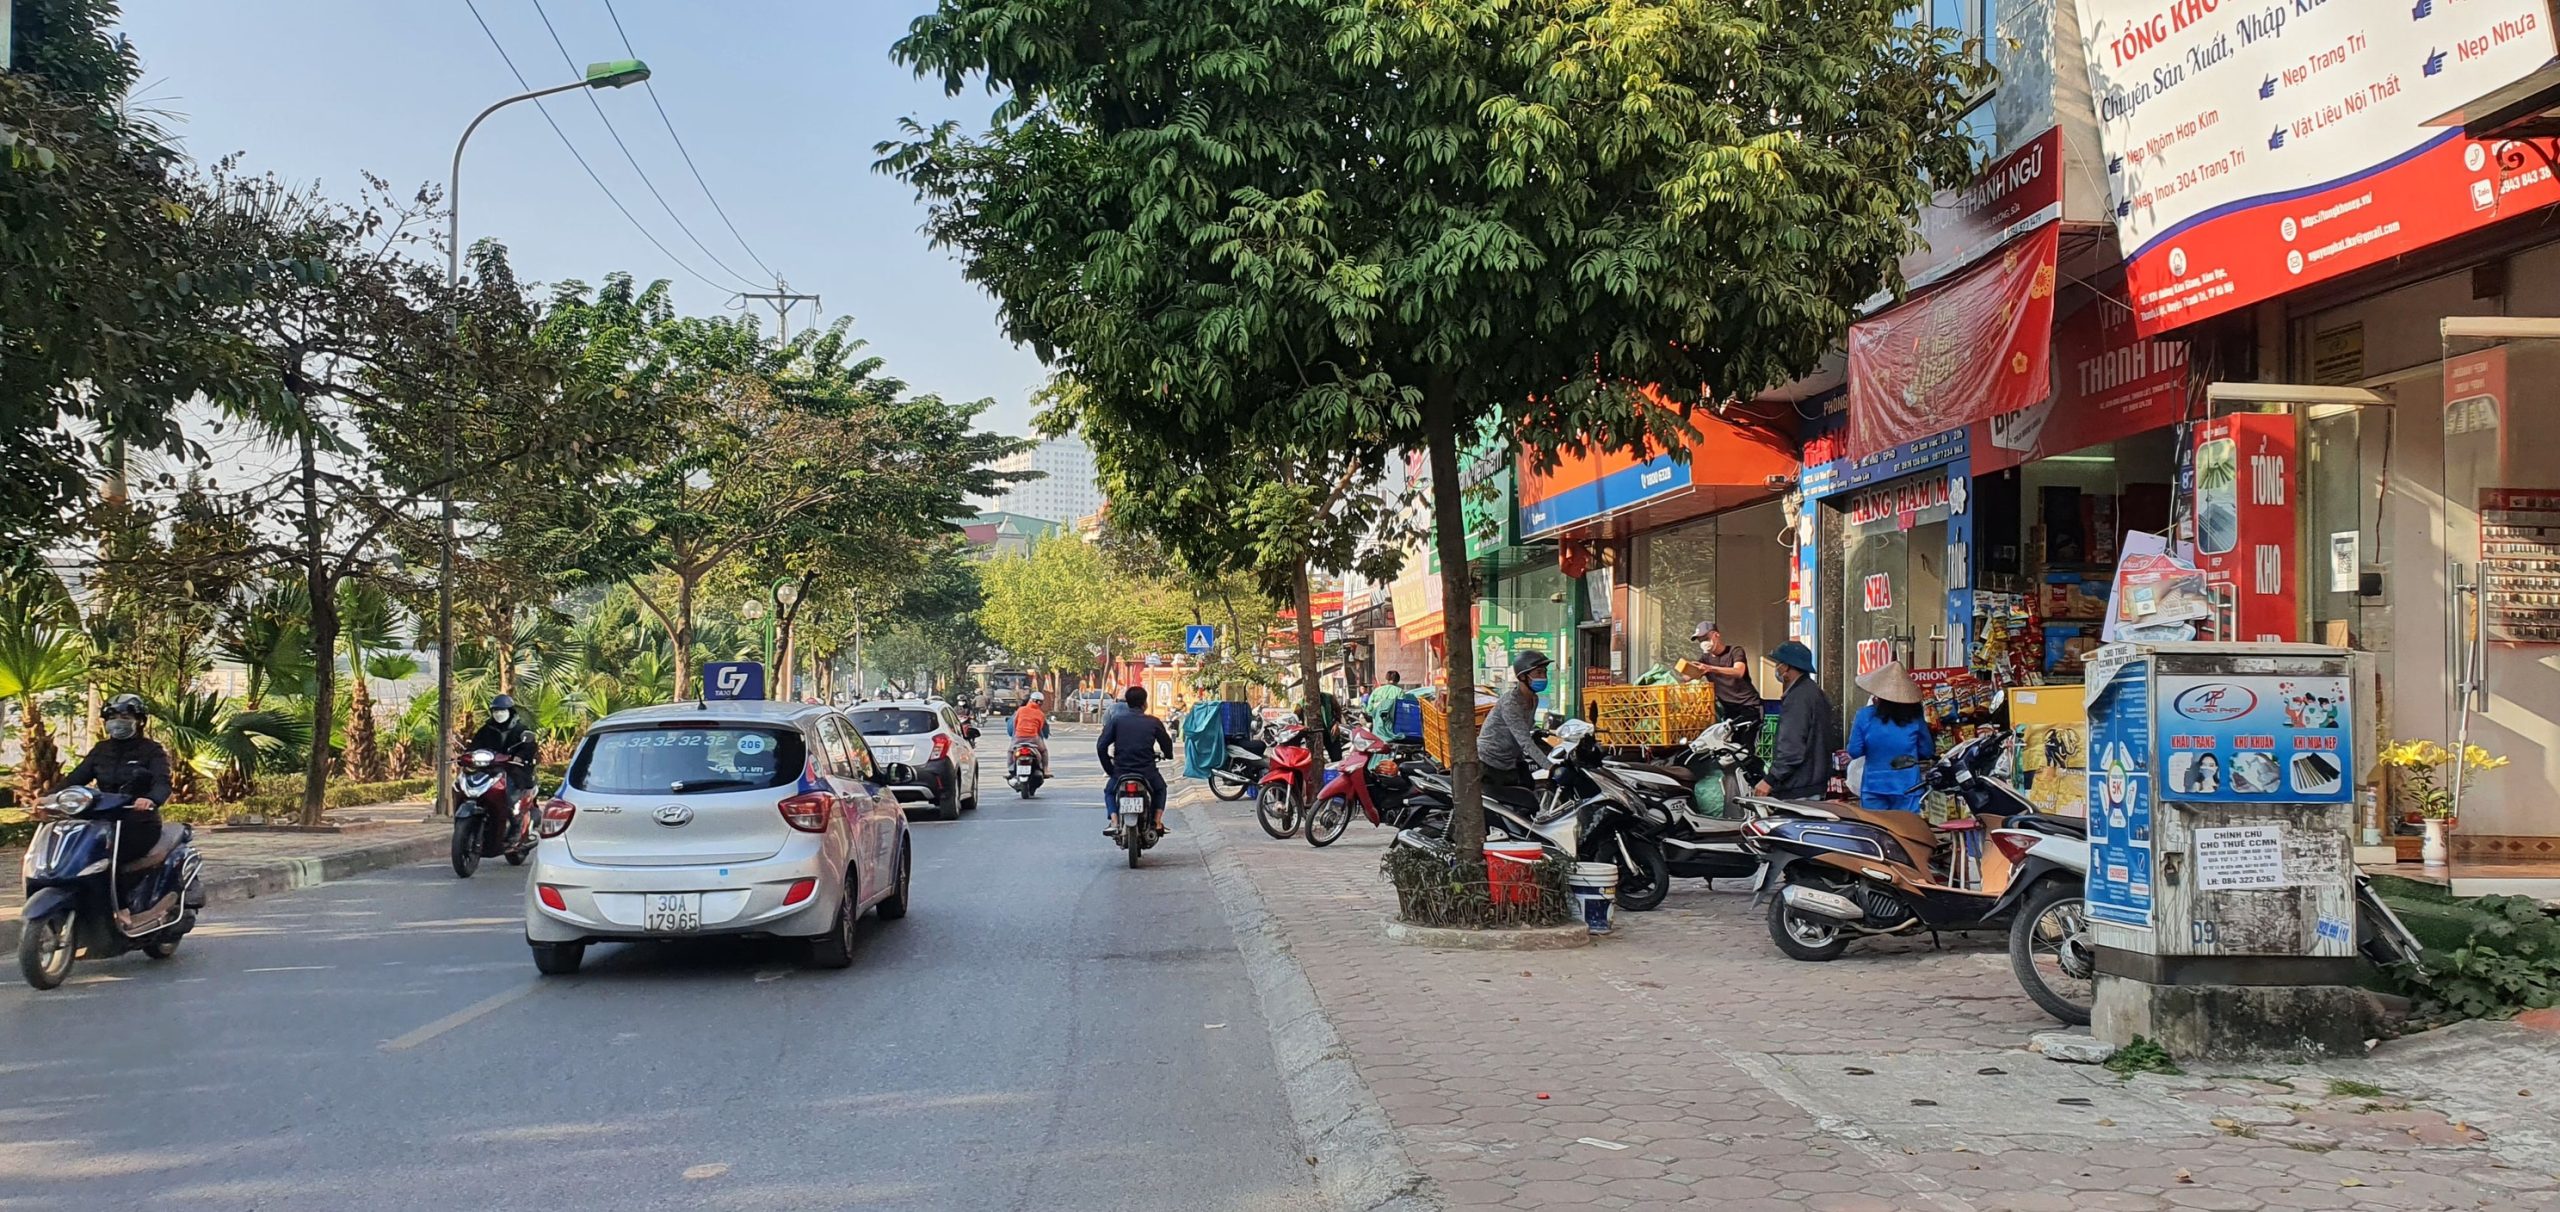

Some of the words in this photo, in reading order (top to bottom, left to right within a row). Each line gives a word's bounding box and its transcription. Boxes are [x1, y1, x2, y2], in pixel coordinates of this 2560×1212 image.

[2110, 14, 2167, 68] TỔNG
[2282, 65, 2308, 88] Nẹp
[2308, 45, 2346, 73] Trang
[2347, 29, 2367, 54] Trí
[2457, 35, 2490, 62] Nẹp
[2492, 13, 2537, 46] Nhựa
[2101, 81, 2152, 122] Chuyên
[2152, 62, 2186, 95] Sản
[2236, 6, 2287, 48] Nhập
[2291, 113, 2315, 138] Vật
[2315, 105, 2343, 128] Liệu
[2344, 89, 2368, 115] Nội
[2368, 73, 2401, 104] Thất
[2126, 147, 2145, 167] Nẹp
[2146, 132, 2175, 157] Nhôm
[2176, 121, 2197, 141] Hợp
[2197, 110, 2219, 131] Kim
[2008, 143, 2043, 193] NGỮ
[2155, 182, 2177, 202] Inox
[2176, 169, 2198, 192] 304
[2198, 158, 2229, 181] Trang
[2250, 434, 2285, 507] TỔNG
[1851, 487, 1893, 527] RĂNG
[1896, 477, 1932, 516] HÀM
[2254, 543, 2282, 596] KHO
[1864, 571, 1893, 613] NHA
[716, 666, 749, 696] G7
[1909, 670, 1948, 682] ORION
[627, 736, 651, 748] 32
[653, 736, 677, 747] 32
[678, 735, 702, 747] 32
[703, 735, 727, 746] 32
[740, 740, 761, 749] 206
[2191, 735, 2216, 749] TRANG
[2293, 735, 2306, 749] KHI
[2307, 735, 2323, 749] MUA
[2112, 781, 2122, 795] 5K
[2200, 841, 2220, 849] CHO
[2248, 838, 2278, 847] CCMN
[2213, 830, 2242, 840] CHÍNH
[2222, 876, 2237, 885] 084
[2239, 875, 2255, 885] 322
[658, 895, 686, 912] 30A
